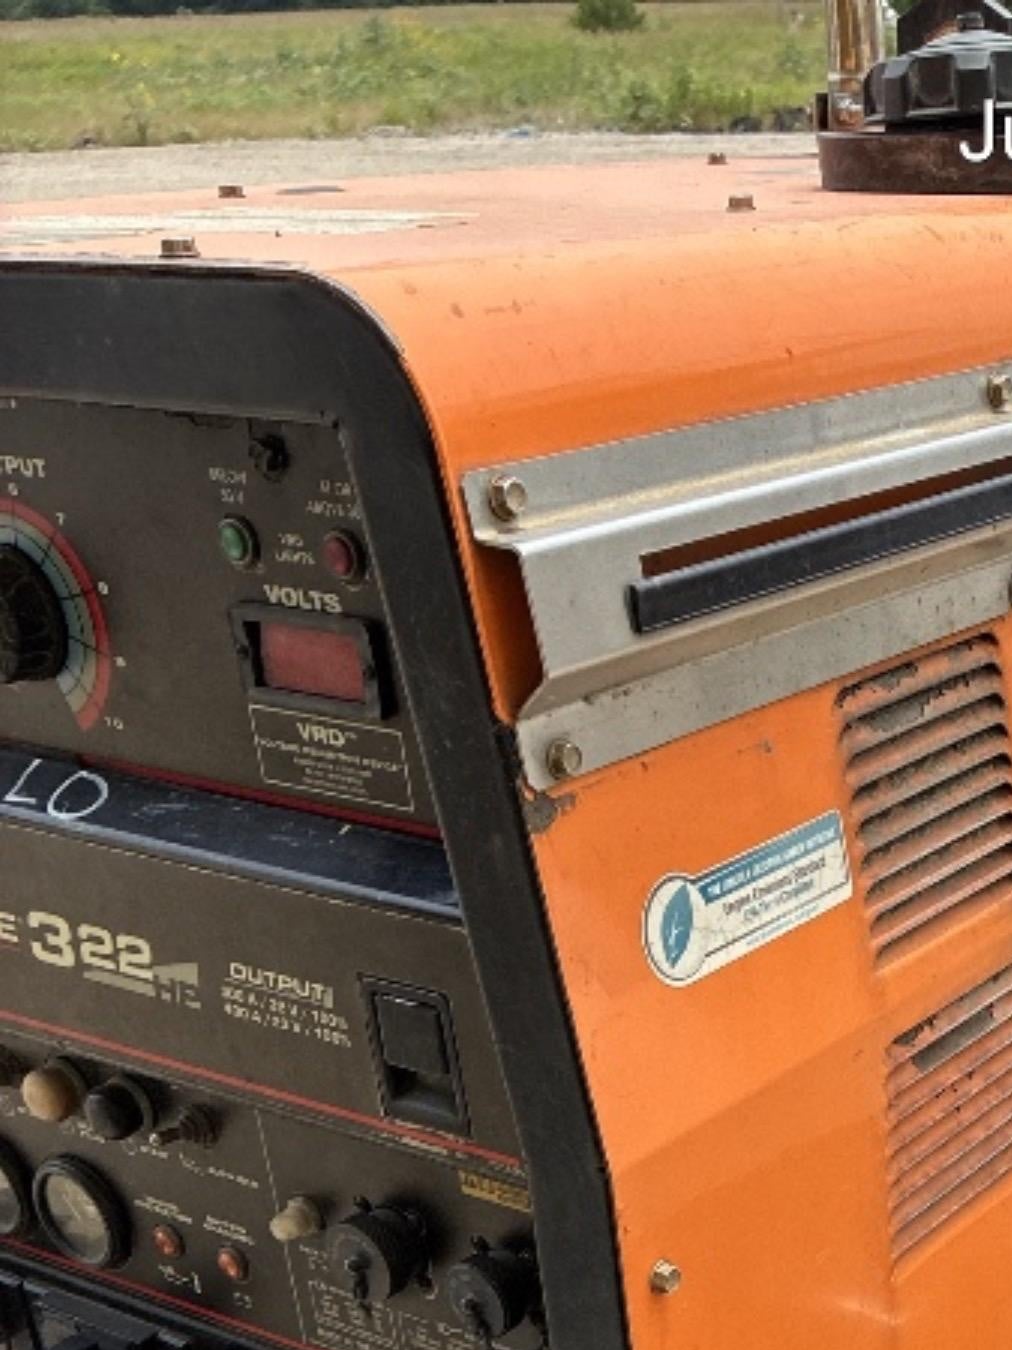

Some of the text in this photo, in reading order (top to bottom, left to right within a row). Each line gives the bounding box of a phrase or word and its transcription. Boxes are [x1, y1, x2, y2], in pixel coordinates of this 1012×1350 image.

[263, 583, 343, 614] VOLTS
[27, 911, 154, 981] 322
[229, 962, 324, 1000] OUTPUT
